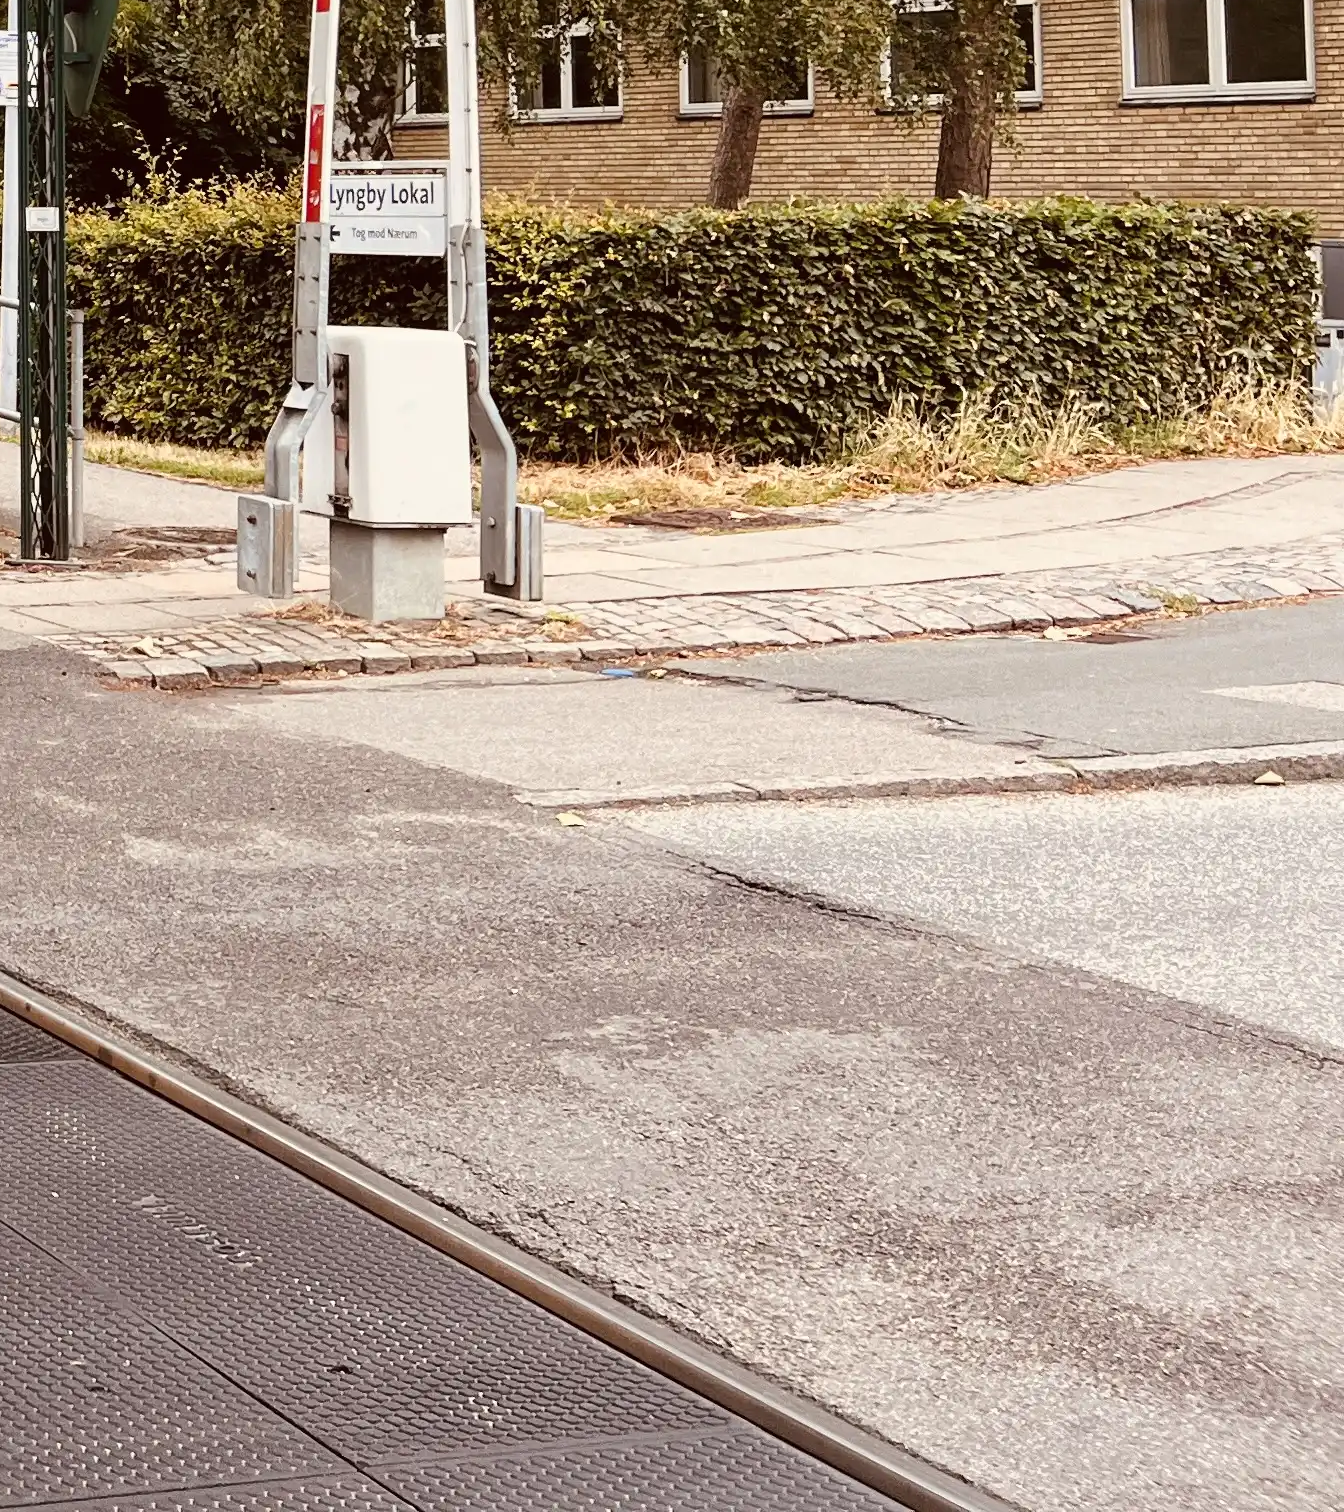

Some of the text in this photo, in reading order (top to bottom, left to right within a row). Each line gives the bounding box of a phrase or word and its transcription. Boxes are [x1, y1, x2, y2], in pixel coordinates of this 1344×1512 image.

[329, 181, 434, 211] Lyngby Lokal
[367, 227, 385, 239] mod
